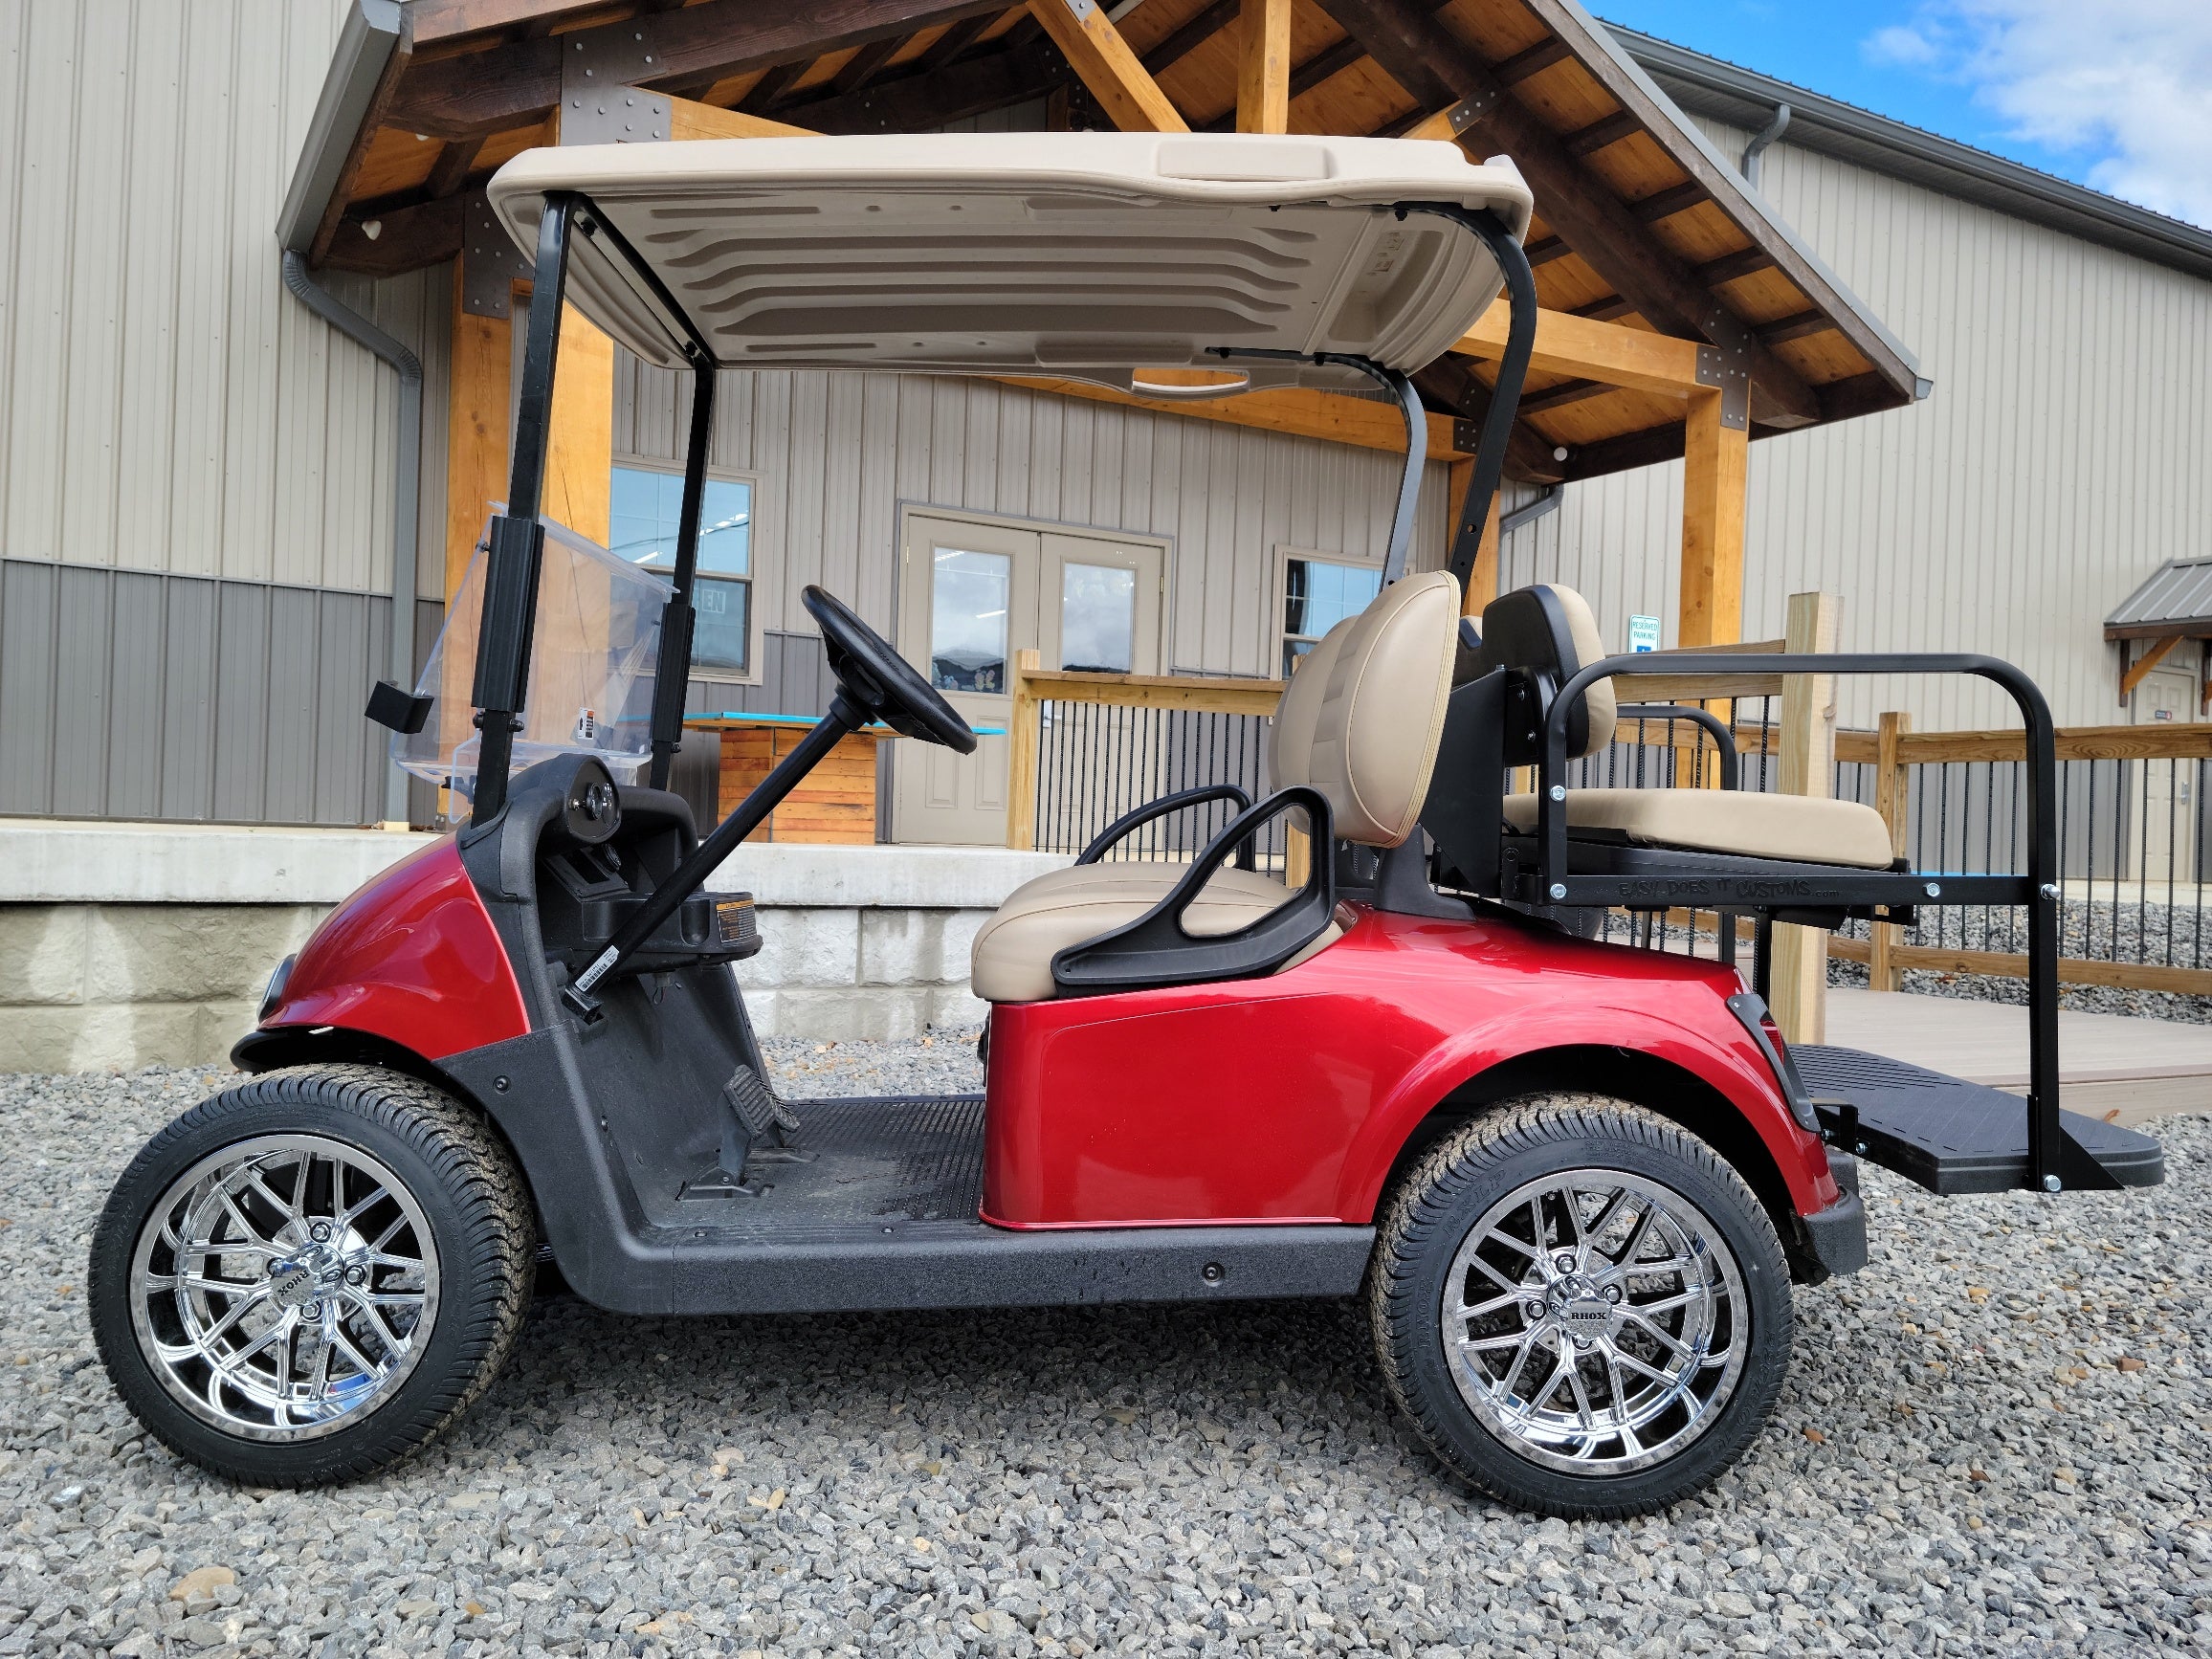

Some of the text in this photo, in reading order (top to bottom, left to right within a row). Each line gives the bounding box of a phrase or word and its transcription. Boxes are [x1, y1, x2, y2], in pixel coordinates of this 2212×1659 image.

[1633, 621, 1657, 630] RESERVED
[1634, 630, 1655, 640] PARKING
[1618, 880, 1659, 897] EASY
[1667, 879, 1709, 896] DOES
[276, 1270, 310, 1296] RHOX
